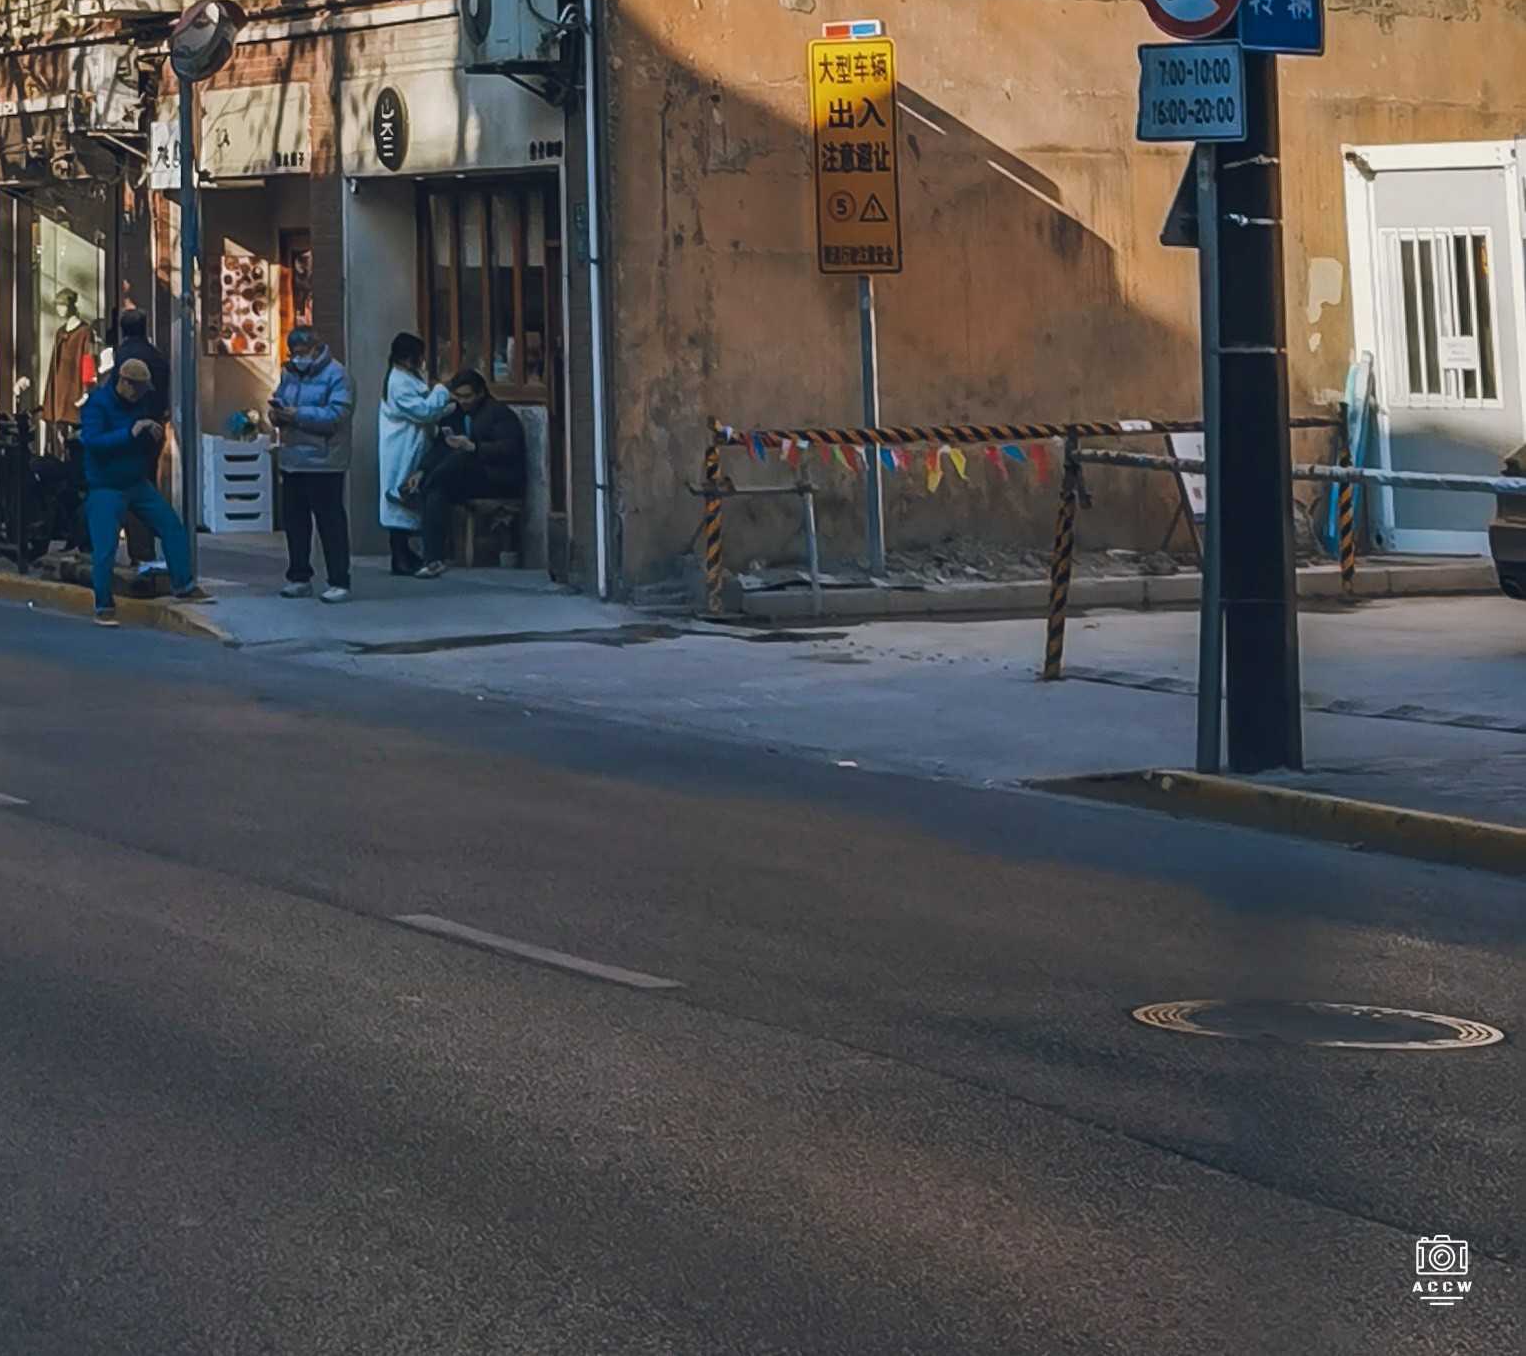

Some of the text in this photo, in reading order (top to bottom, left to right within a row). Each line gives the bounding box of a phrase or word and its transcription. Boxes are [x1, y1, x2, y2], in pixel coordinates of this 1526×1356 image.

[818, 52, 888, 84] 大型车辆
[828, 97, 886, 129] 出入
[822, 141, 891, 173] 注意避让
[836, 199, 848, 215] 5
